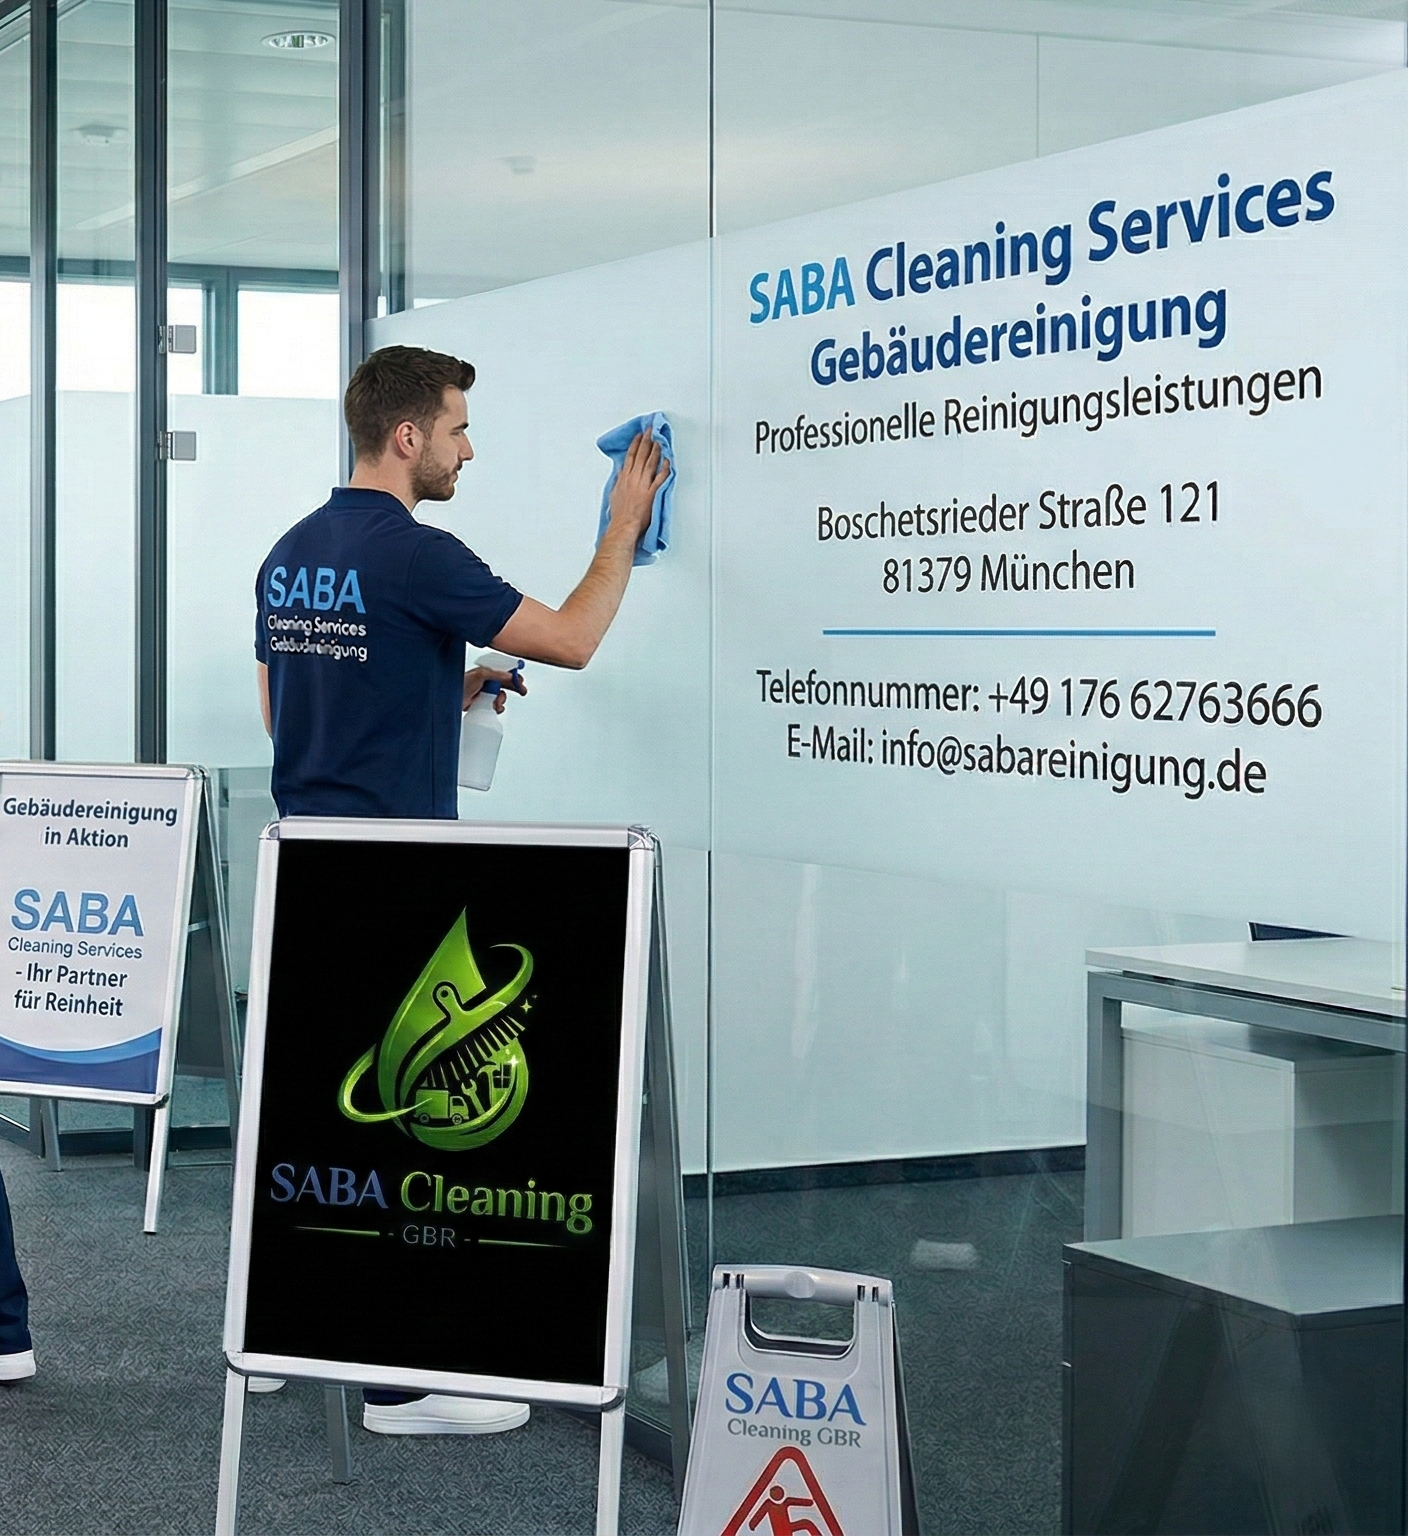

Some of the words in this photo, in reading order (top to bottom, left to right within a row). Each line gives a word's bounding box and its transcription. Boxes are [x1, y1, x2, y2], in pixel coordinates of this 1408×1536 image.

[750, 256, 855, 324] SABA
[866, 222, 1071, 302] Cleaning
[1088, 169, 1334, 261] Services
[811, 288, 1227, 385] Gebäudereinigung
[756, 401, 935, 454] Professionelle
[944, 364, 1322, 439] Reinigungsleistungen
[818, 494, 1029, 542] Boschetsrieder
[1039, 485, 1146, 530] Straße
[1160, 481, 1219, 523] 121
[268, 566, 366, 614] SABA
[883, 556, 971, 593] 81379
[981, 551, 1134, 592] München
[757, 670, 979, 713] Telefonnummer:
[988, 677, 1049, 714] +49
[1061, 678, 1120, 720] 176
[1130, 681, 1322, 727] 62763666
[788, 725, 874, 765] E-Mail:
[882, 730, 1266, 800] info@sabareinigung.de
[3, 798, 178, 826] Gebäudereinigung
[45, 827, 62, 845] in
[67, 828, 128, 848] Aktion
[11, 889, 144, 937] SABA
[8, 938, 73, 957] Cleaning
[77, 941, 142, 959] Services
[27, 964, 52, 982] Ihr
[57, 966, 128, 987] Partner
[14, 990, 40, 1010] für
[46, 992, 123, 1016] Reinheit
[270, 1163, 388, 1210] SABA
[401, 1172, 593, 1235] Cleaning
[402, 1226, 456, 1248] GBR
[726, 1373, 866, 1426] SABA
[728, 1418, 811, 1446] Cleaning
[817, 1427, 861, 1448] GBR
